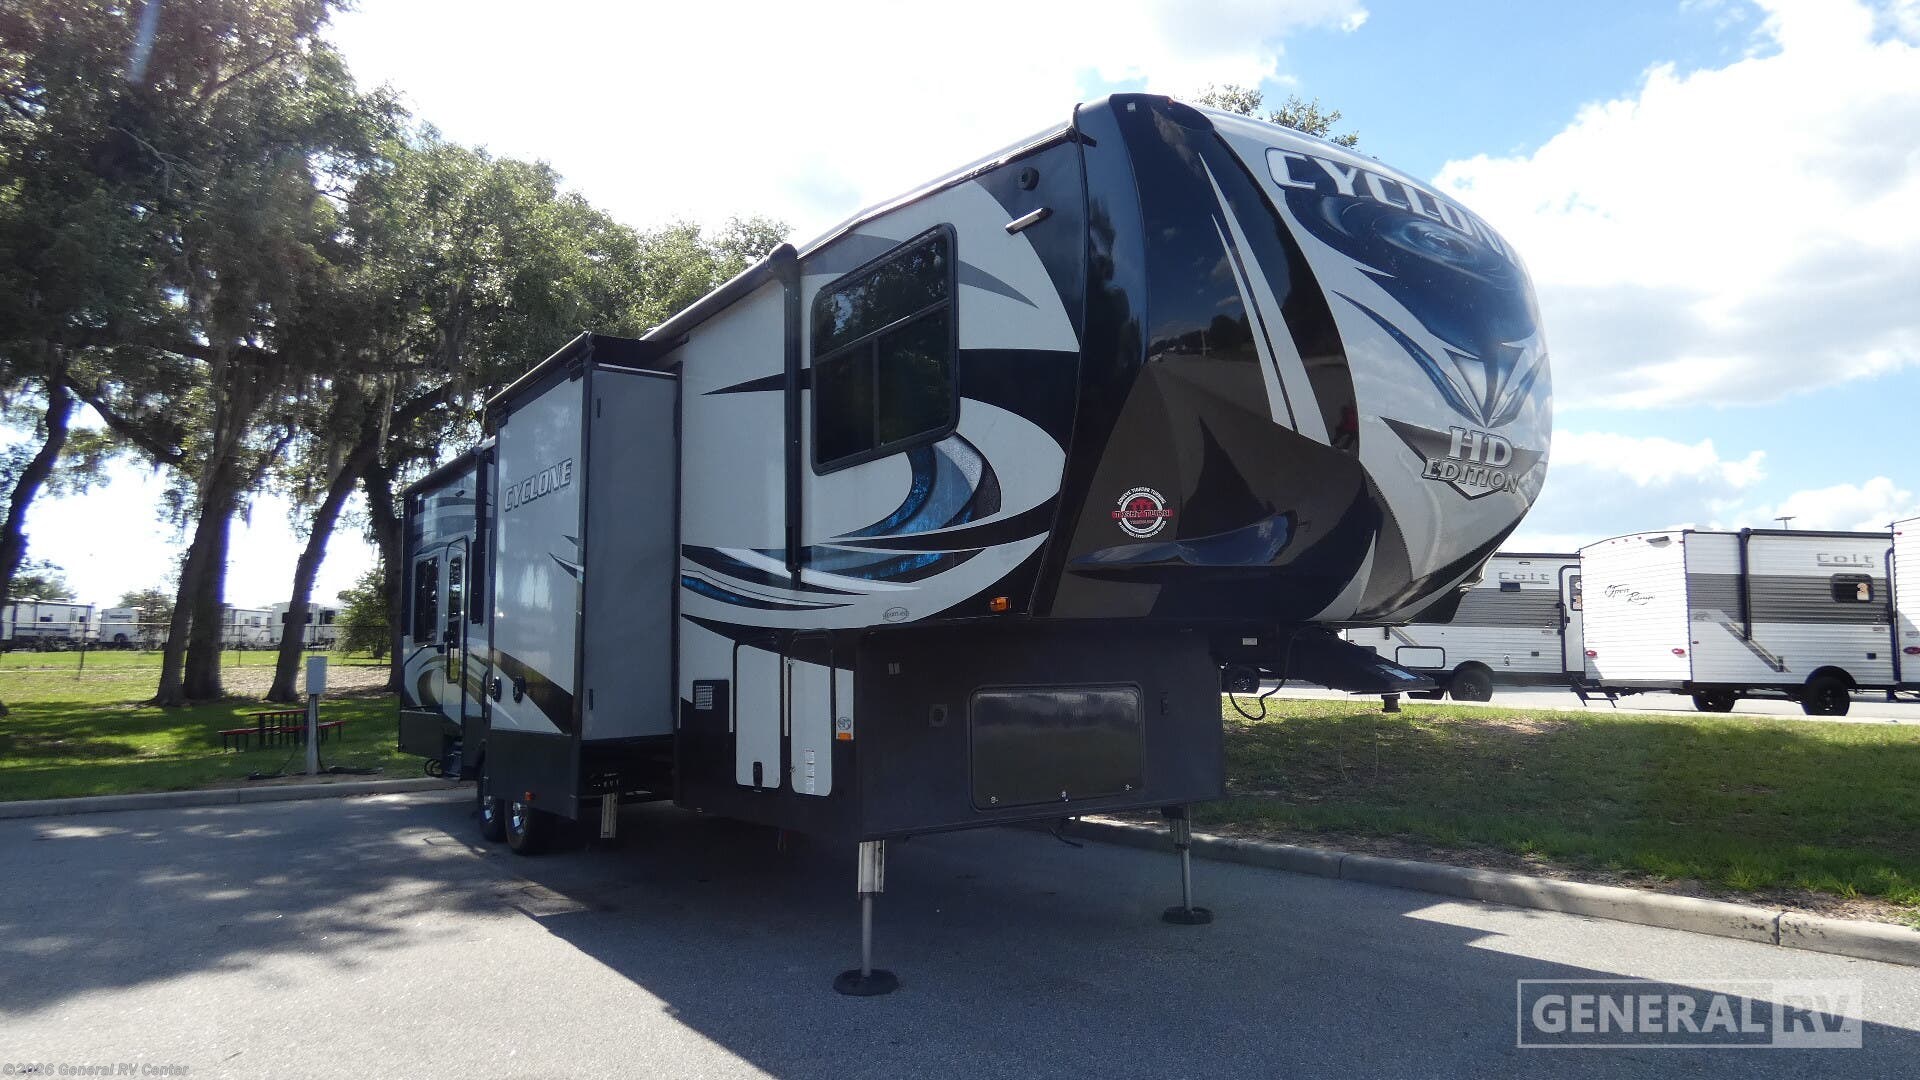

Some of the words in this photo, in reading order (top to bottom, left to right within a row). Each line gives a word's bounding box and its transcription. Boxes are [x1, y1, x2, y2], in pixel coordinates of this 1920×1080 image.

[1447, 426, 1514, 468] HD
[504, 458, 573, 512] CYCLONE
[1422, 457, 1520, 494] EDITION
[1499, 571, 1550, 580] Colt
[1816, 553, 1873, 563] Colt
